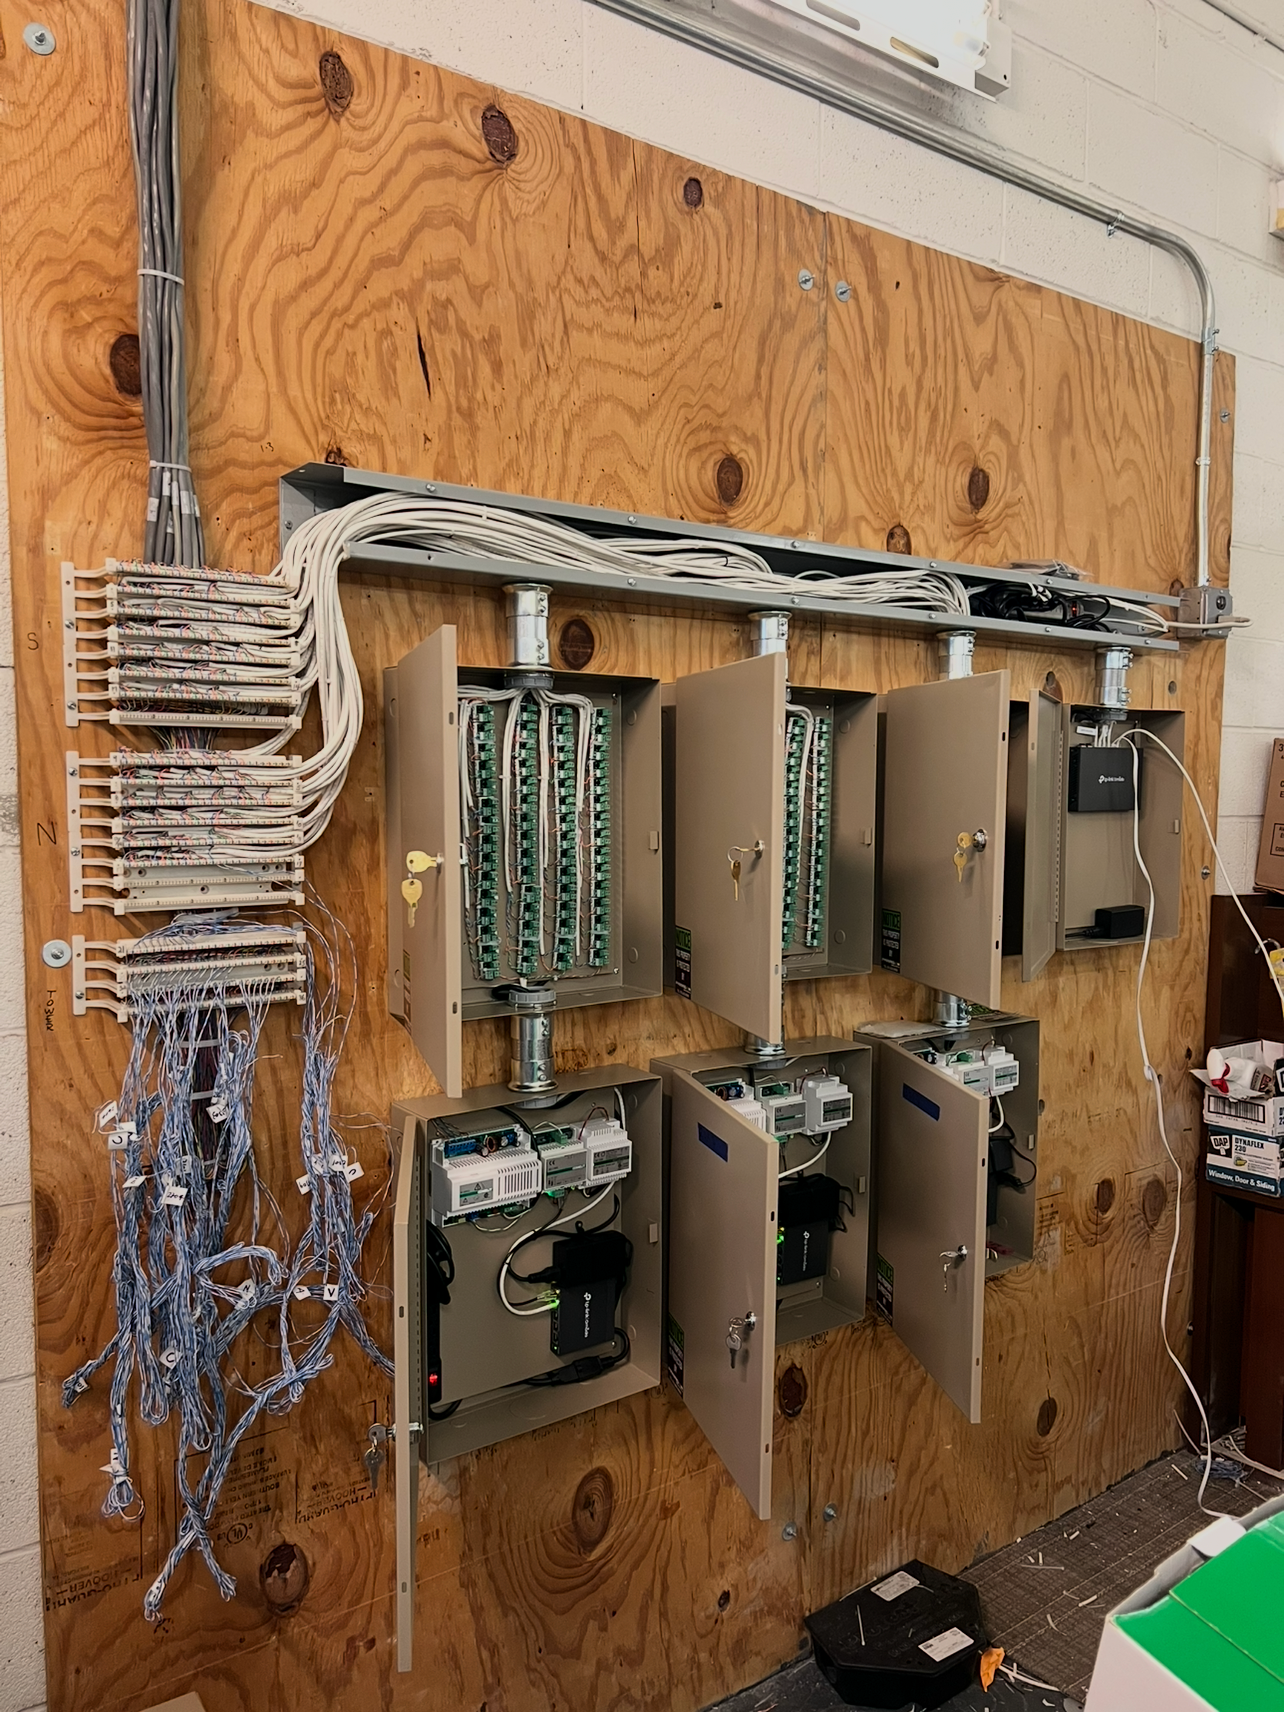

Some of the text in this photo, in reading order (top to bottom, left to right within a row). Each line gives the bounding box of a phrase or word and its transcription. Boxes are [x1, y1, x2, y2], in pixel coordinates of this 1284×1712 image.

[27, 632, 39, 650] S
[37, 820, 57, 846] N
[1213, 1137, 1229, 1147] DAP
[1234, 1137, 1265, 1149] DYNAFLEX
[1208, 1169, 1276, 1192] Window, Door & Siding
